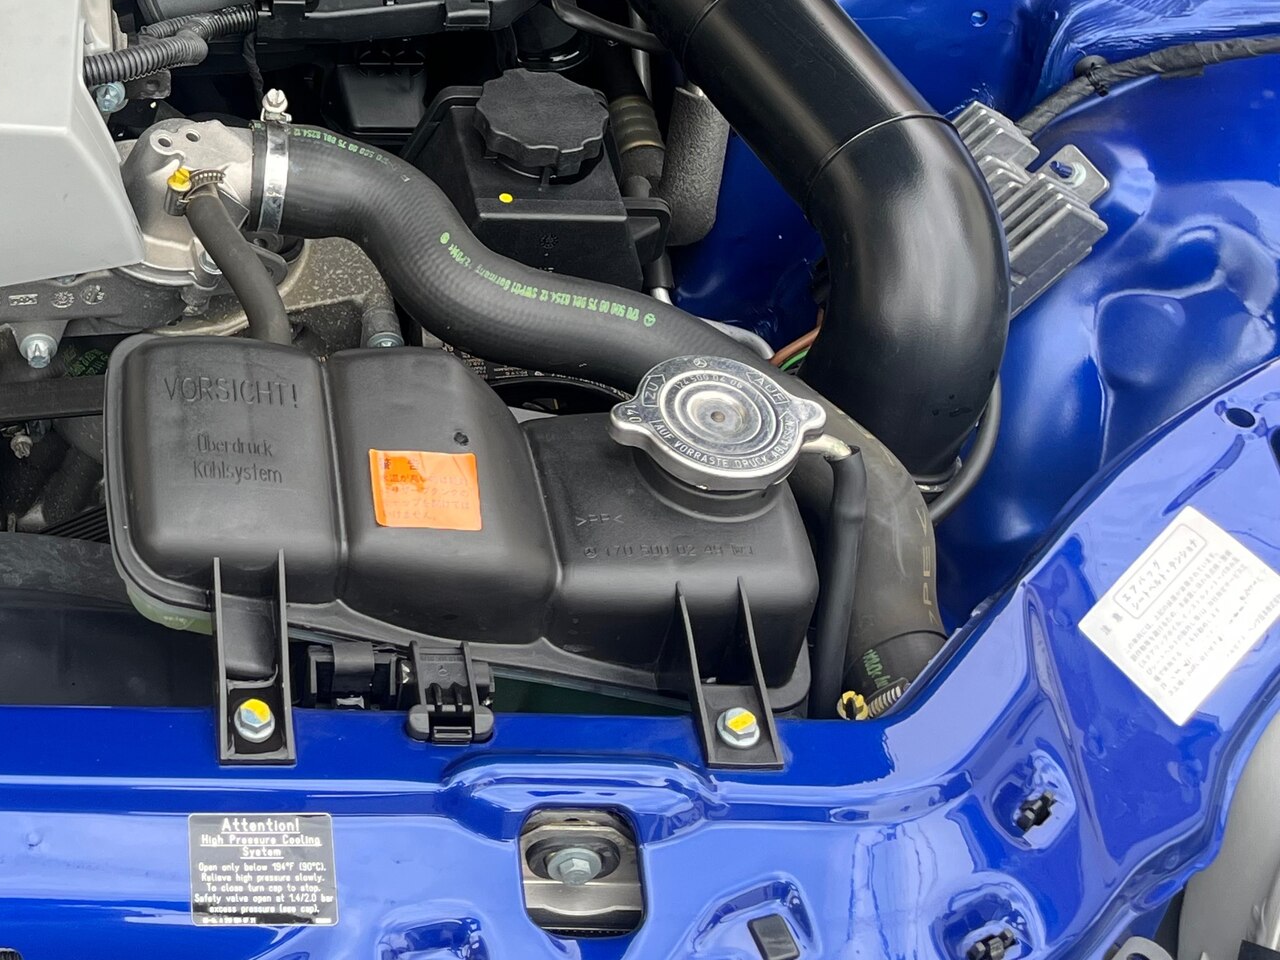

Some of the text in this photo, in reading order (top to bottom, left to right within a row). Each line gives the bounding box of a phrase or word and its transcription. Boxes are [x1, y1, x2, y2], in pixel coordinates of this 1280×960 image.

[164, 376, 298, 408] VORSICHT!
[644, 382, 662, 399] ZU
[753, 375, 786, 404] AUF
[624, 404, 642, 423] 140
[653, 420, 796, 468] AUF VORRASTE DRUCK ABLASSEN
[221, 818, 300, 831] Attention!
[201, 834, 321, 846] High Pressure Cooling
[242, 847, 281, 857] System
[198, 862, 217, 872] Open
[222, 863, 239, 872] only
[244, 862, 268, 871] below
[202, 873, 325, 883] Relieve high pressure slowly.
[206, 883, 321, 893] To close turn cap to stop.
[194, 894, 221, 904] Safety
[226, 894, 249, 902] valve
[253, 895, 272, 904] open
[276, 894, 285, 902] at
[321, 894, 334, 902] bar
[241, 906, 275, 914] pressure
[279, 904, 296, 914] (see
